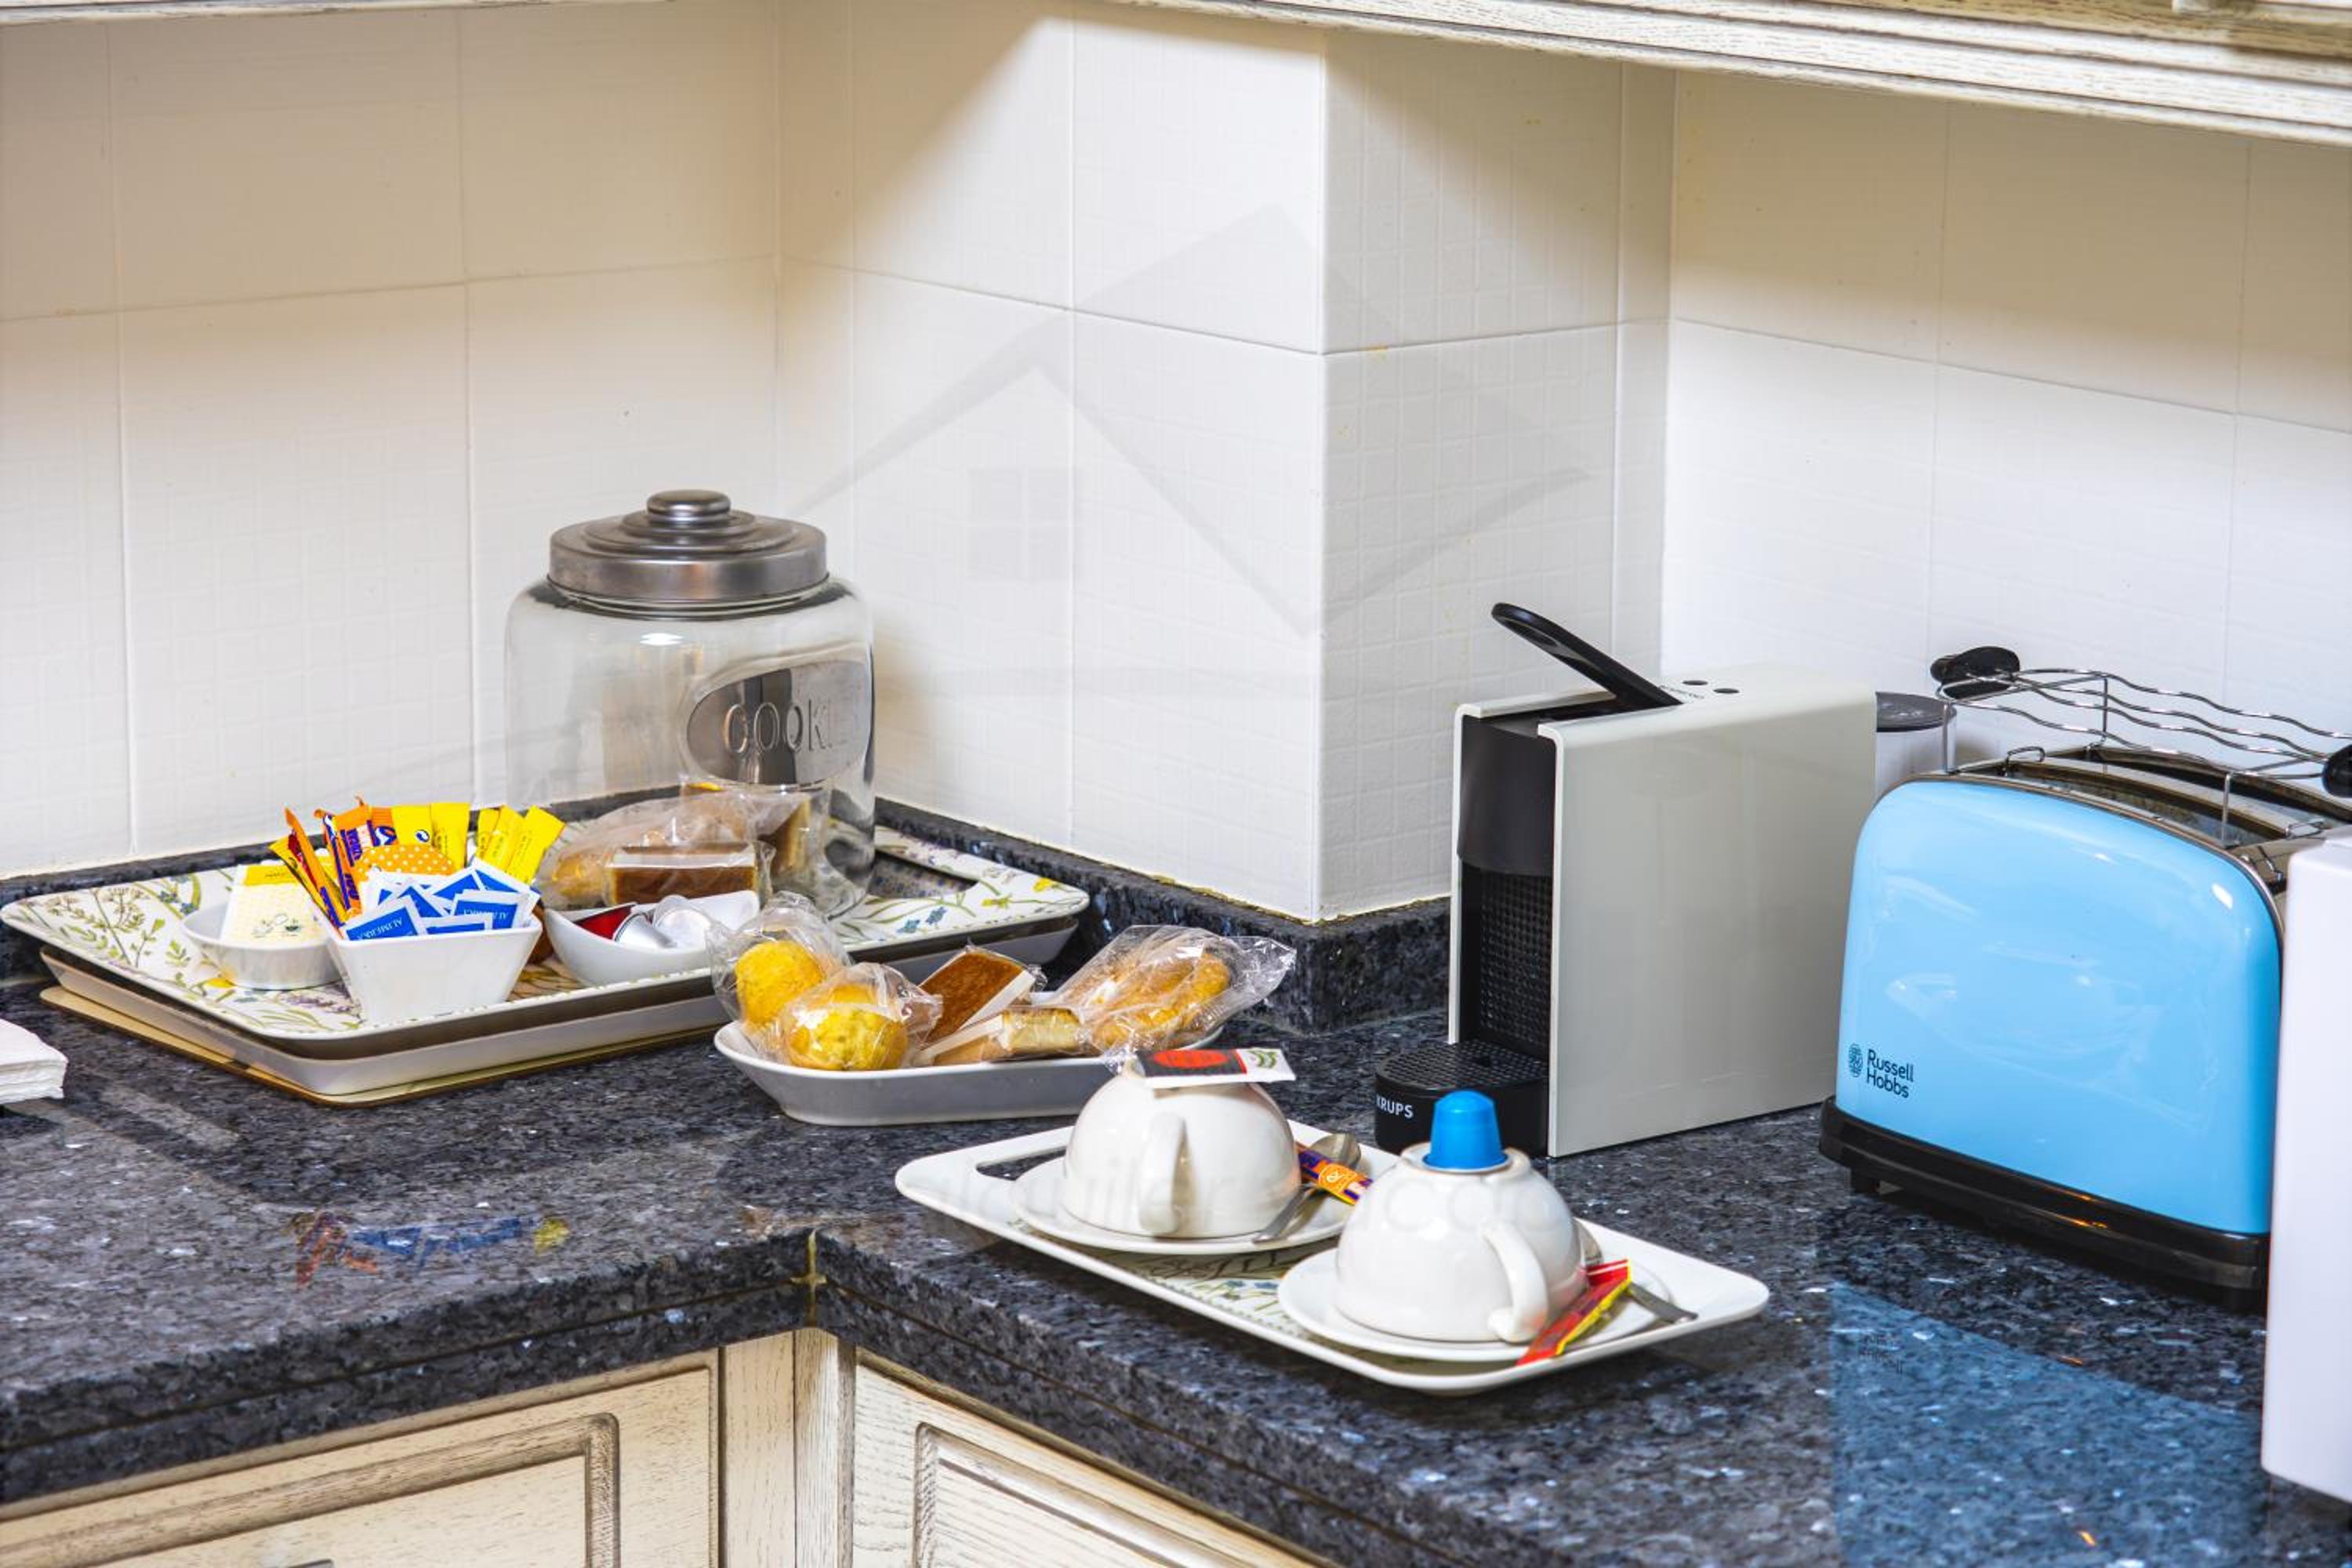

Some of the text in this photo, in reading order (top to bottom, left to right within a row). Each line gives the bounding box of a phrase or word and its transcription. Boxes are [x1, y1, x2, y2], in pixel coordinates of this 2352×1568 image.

[1867, 1049, 1914, 1083] Russell
[1867, 1068, 1909, 1098] Hobbs
[1376, 1094, 1414, 1119] KRUPS
